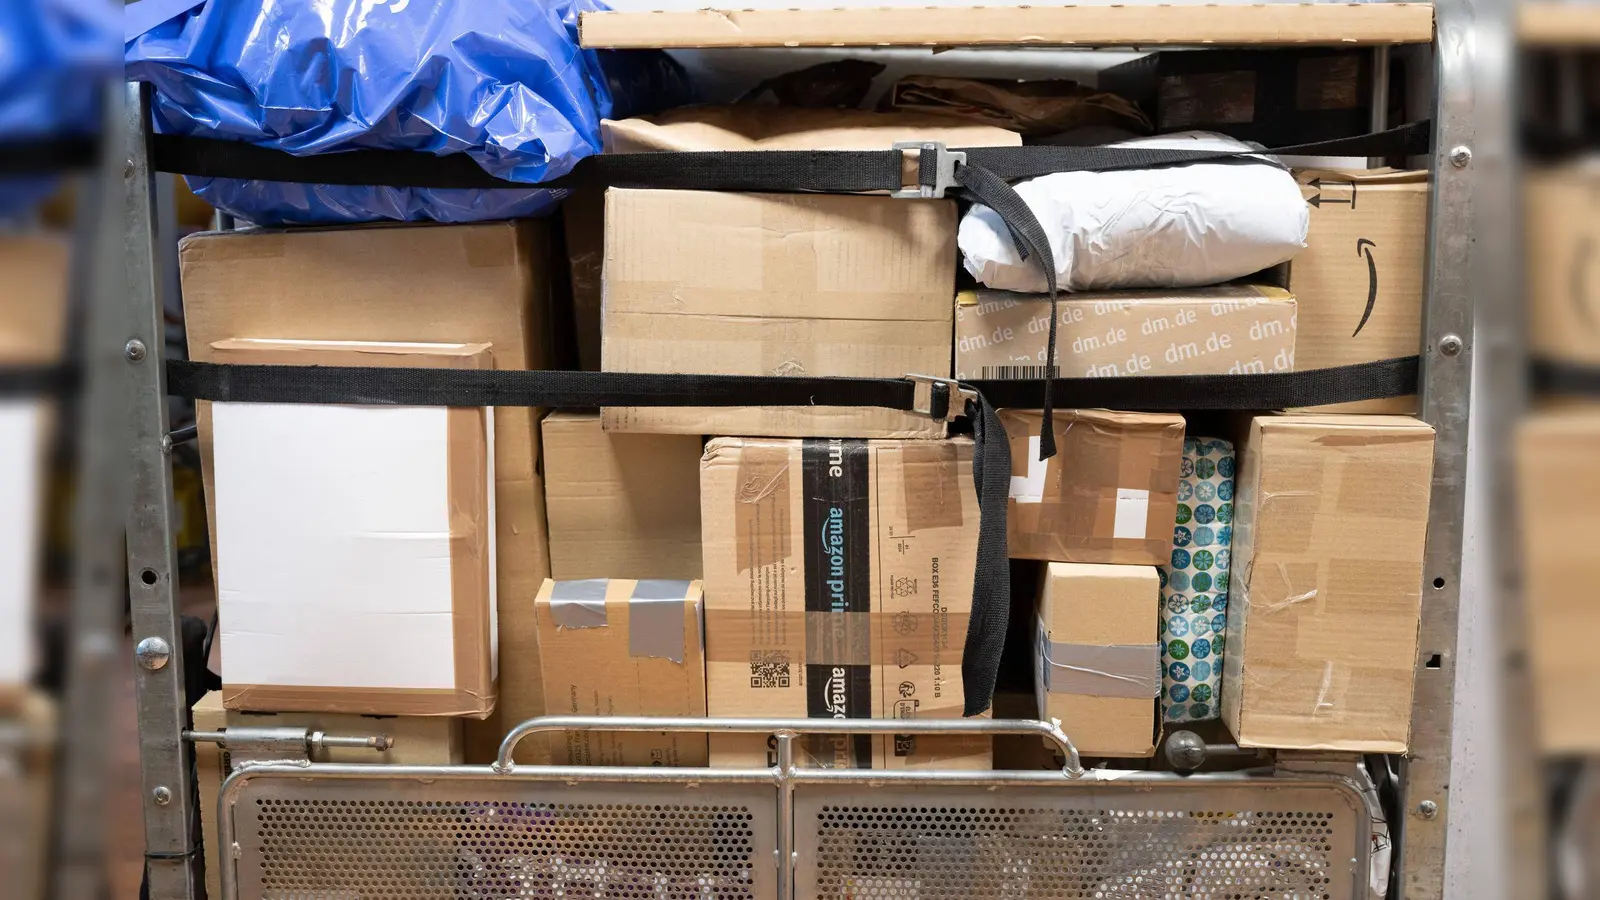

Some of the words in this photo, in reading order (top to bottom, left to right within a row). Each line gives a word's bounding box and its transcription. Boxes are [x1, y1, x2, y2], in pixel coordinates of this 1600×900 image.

[959, 326, 1014, 353] dm.de
[1072, 327, 1128, 354] dm.de
[1141, 308, 1197, 335] dm.de
[1086, 353, 1152, 377] dm.de
[1165, 332, 1232, 363] dm.de
[829, 507, 844, 577] amazon
[931, 557, 939, 574] BOX
[932, 589, 941, 615] FEFCO
[933, 677, 942, 691] 1.10
[570, 684, 578, 713] Germany
